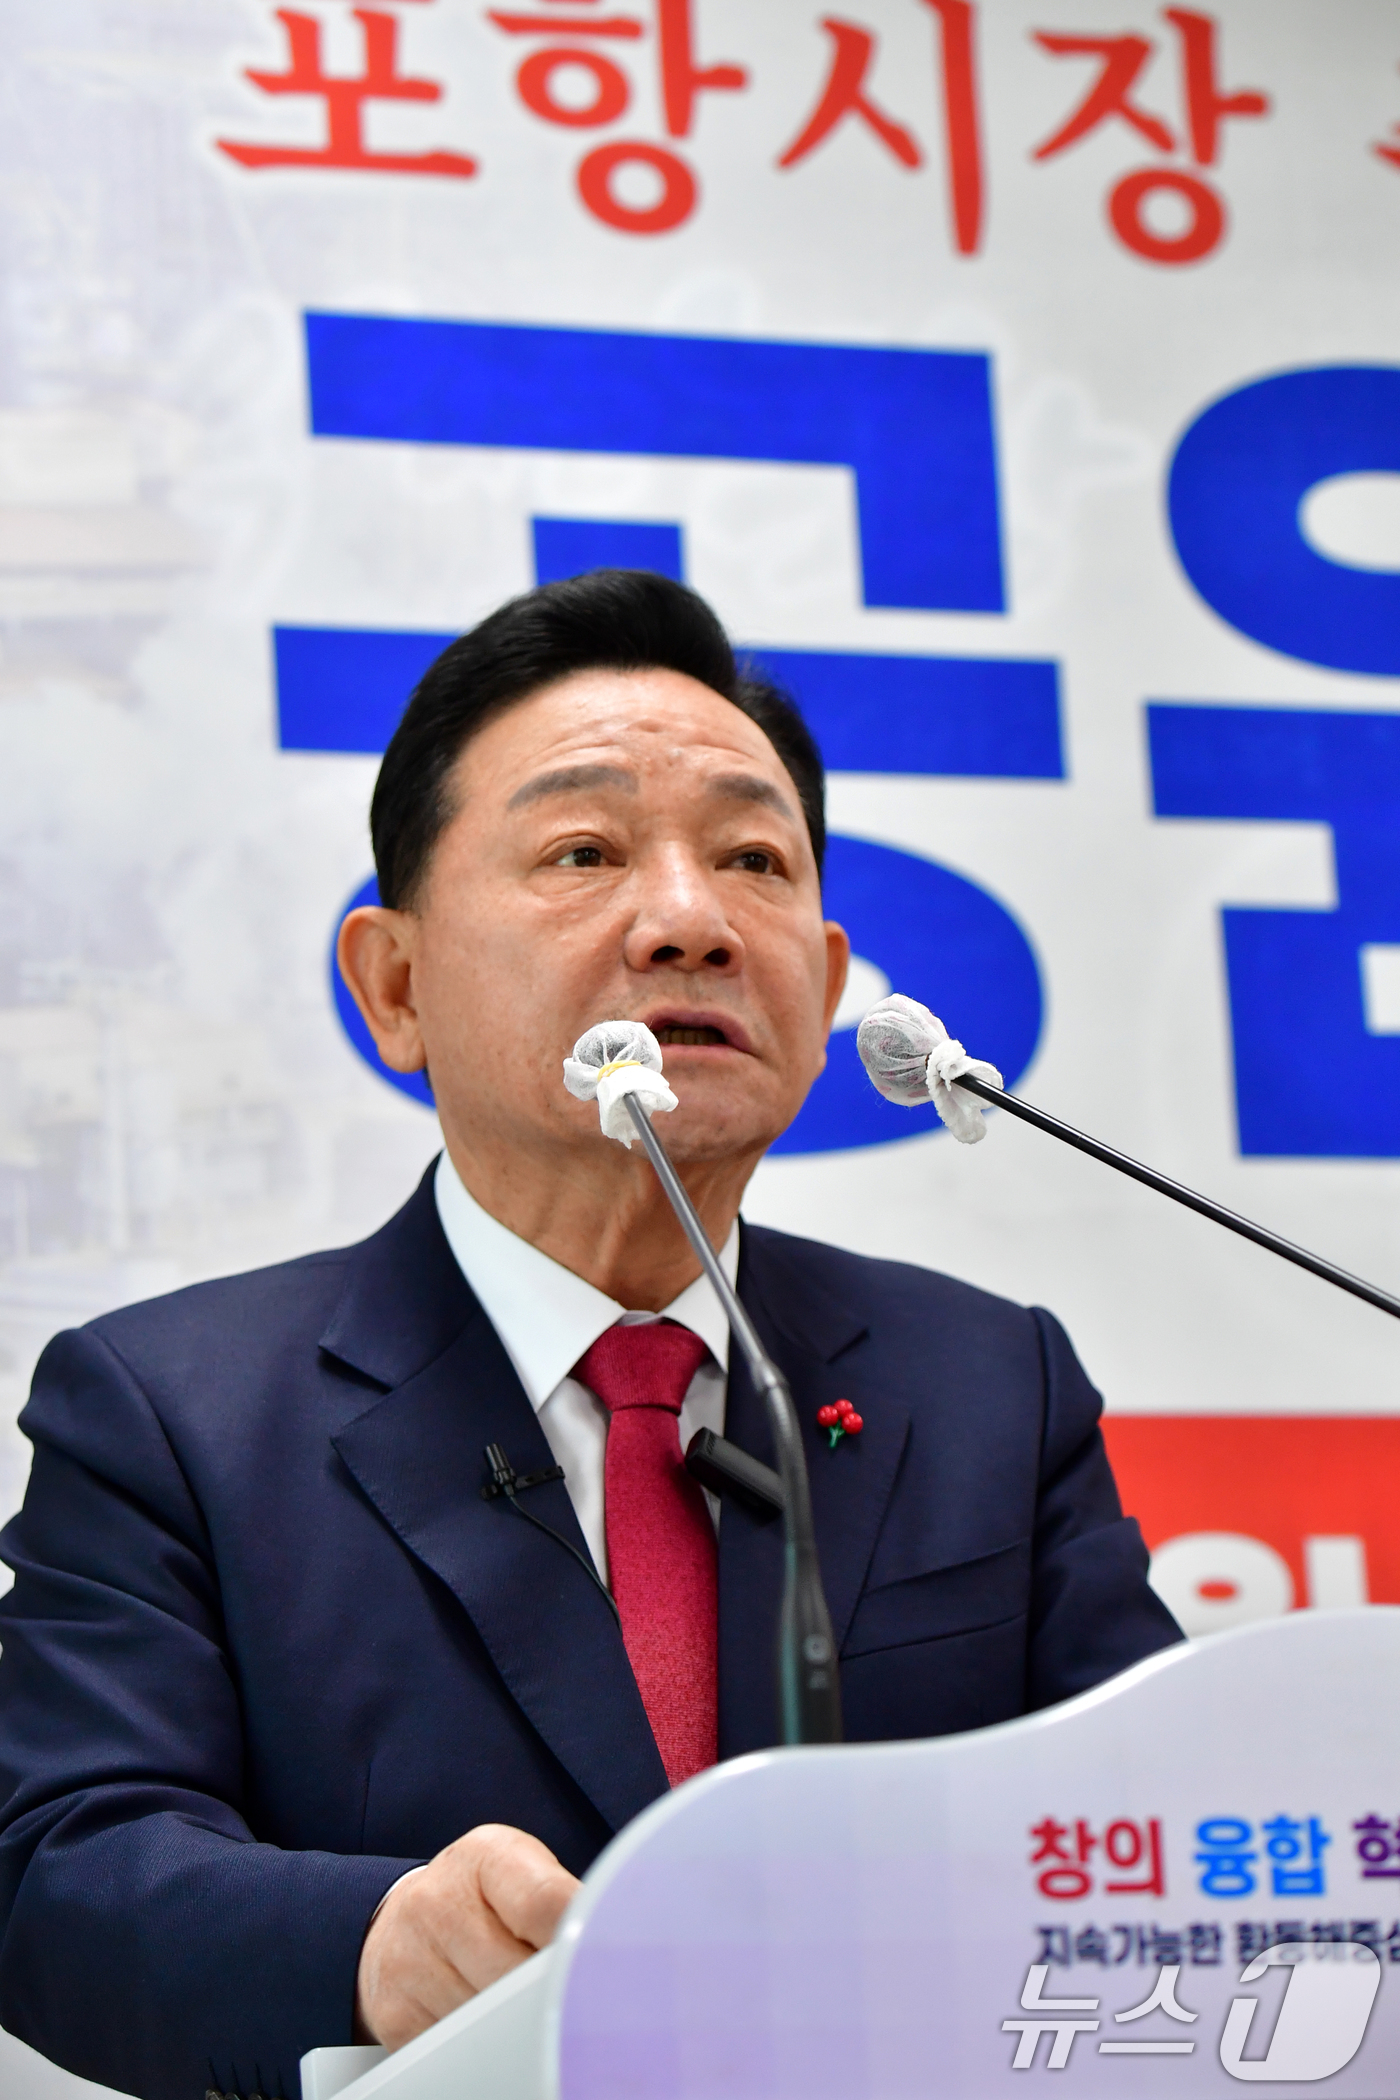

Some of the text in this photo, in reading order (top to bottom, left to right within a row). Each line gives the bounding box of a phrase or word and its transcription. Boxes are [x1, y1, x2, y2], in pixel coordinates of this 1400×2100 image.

[214, 0, 1270, 266] 포항시장
[1029, 1816, 1167, 1899] 창의
[1194, 1813, 1331, 1898] 융합
[1034, 1920, 1222, 1968] 지속가능한
